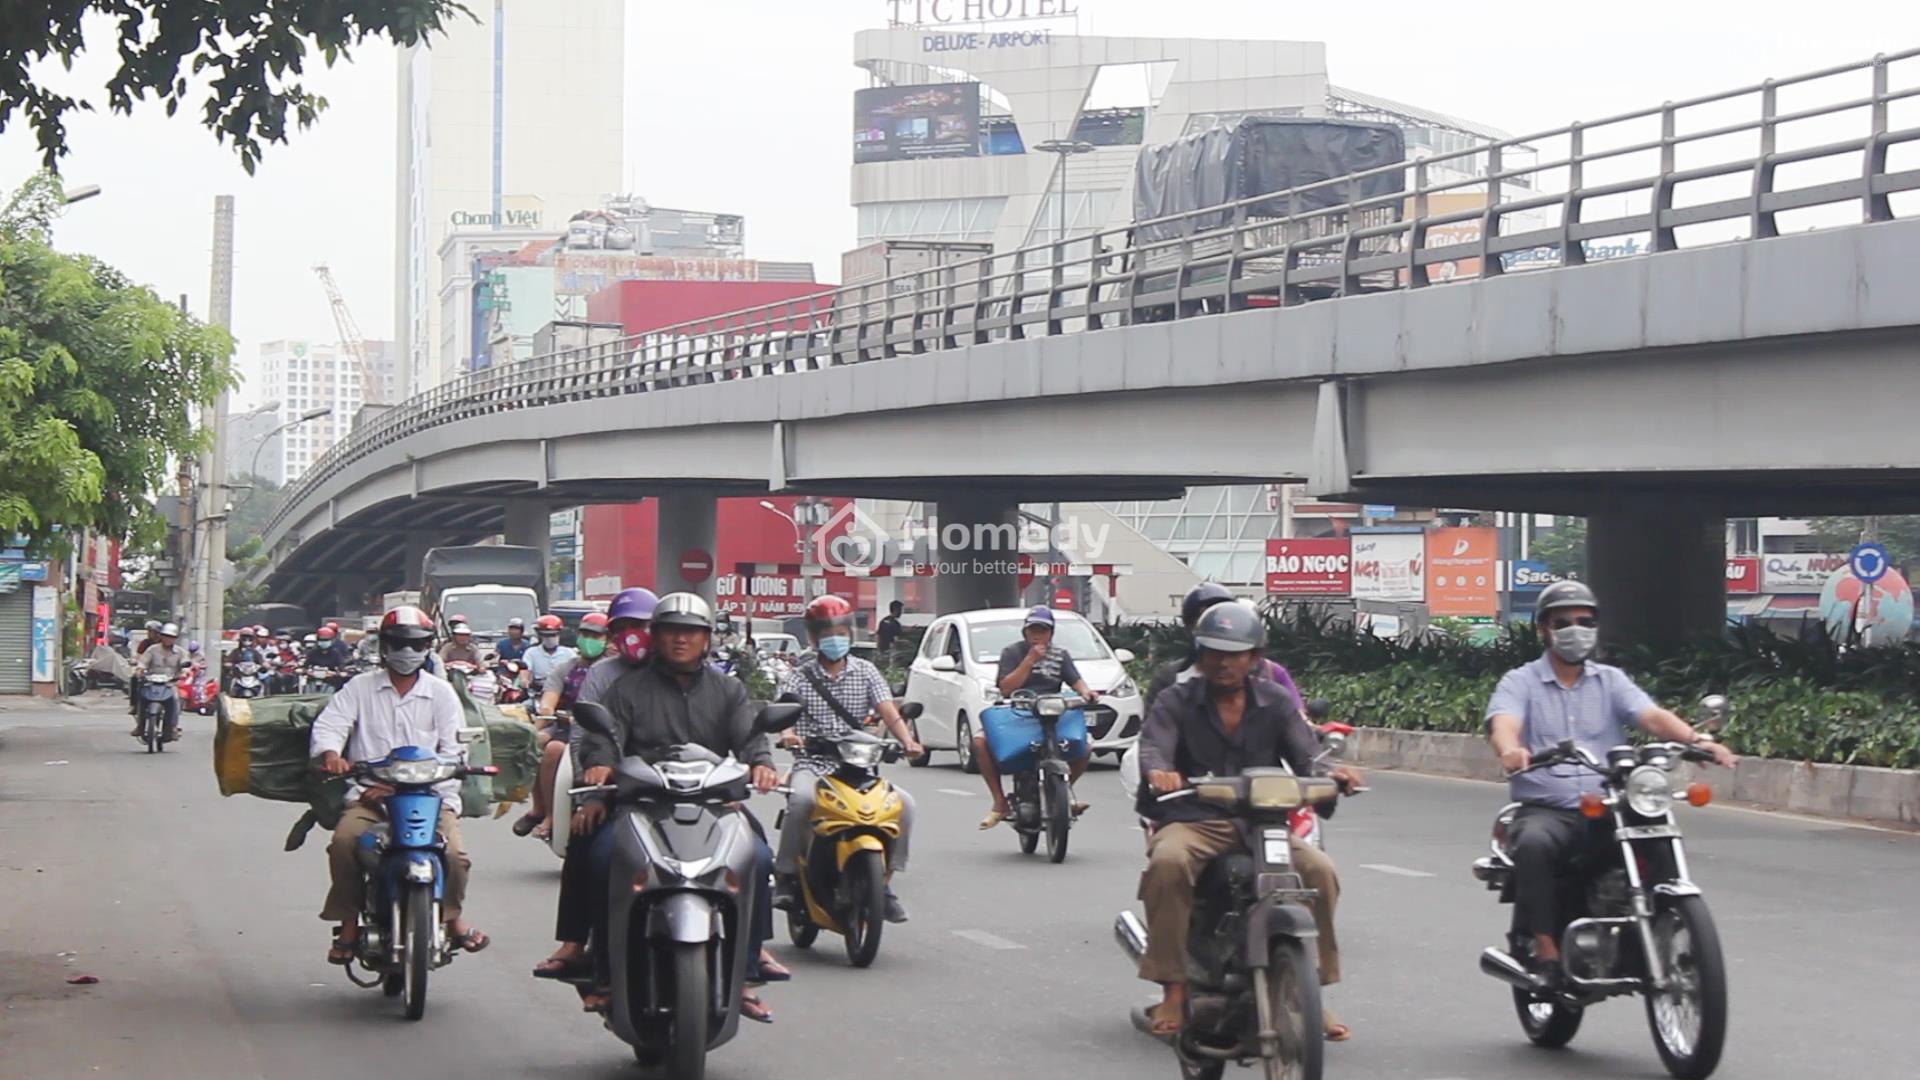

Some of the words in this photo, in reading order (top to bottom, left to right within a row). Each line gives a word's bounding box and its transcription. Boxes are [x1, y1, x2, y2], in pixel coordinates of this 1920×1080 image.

[887, 0, 952, 25] TTC
[963, 0, 1079, 20] HOTEL
[988, 28, 1051, 48] AIRPORT
[1267, 546, 1299, 573] BẢO
[1302, 554, 1348, 579] NGỌC
[792, 577, 827, 597] MNH
